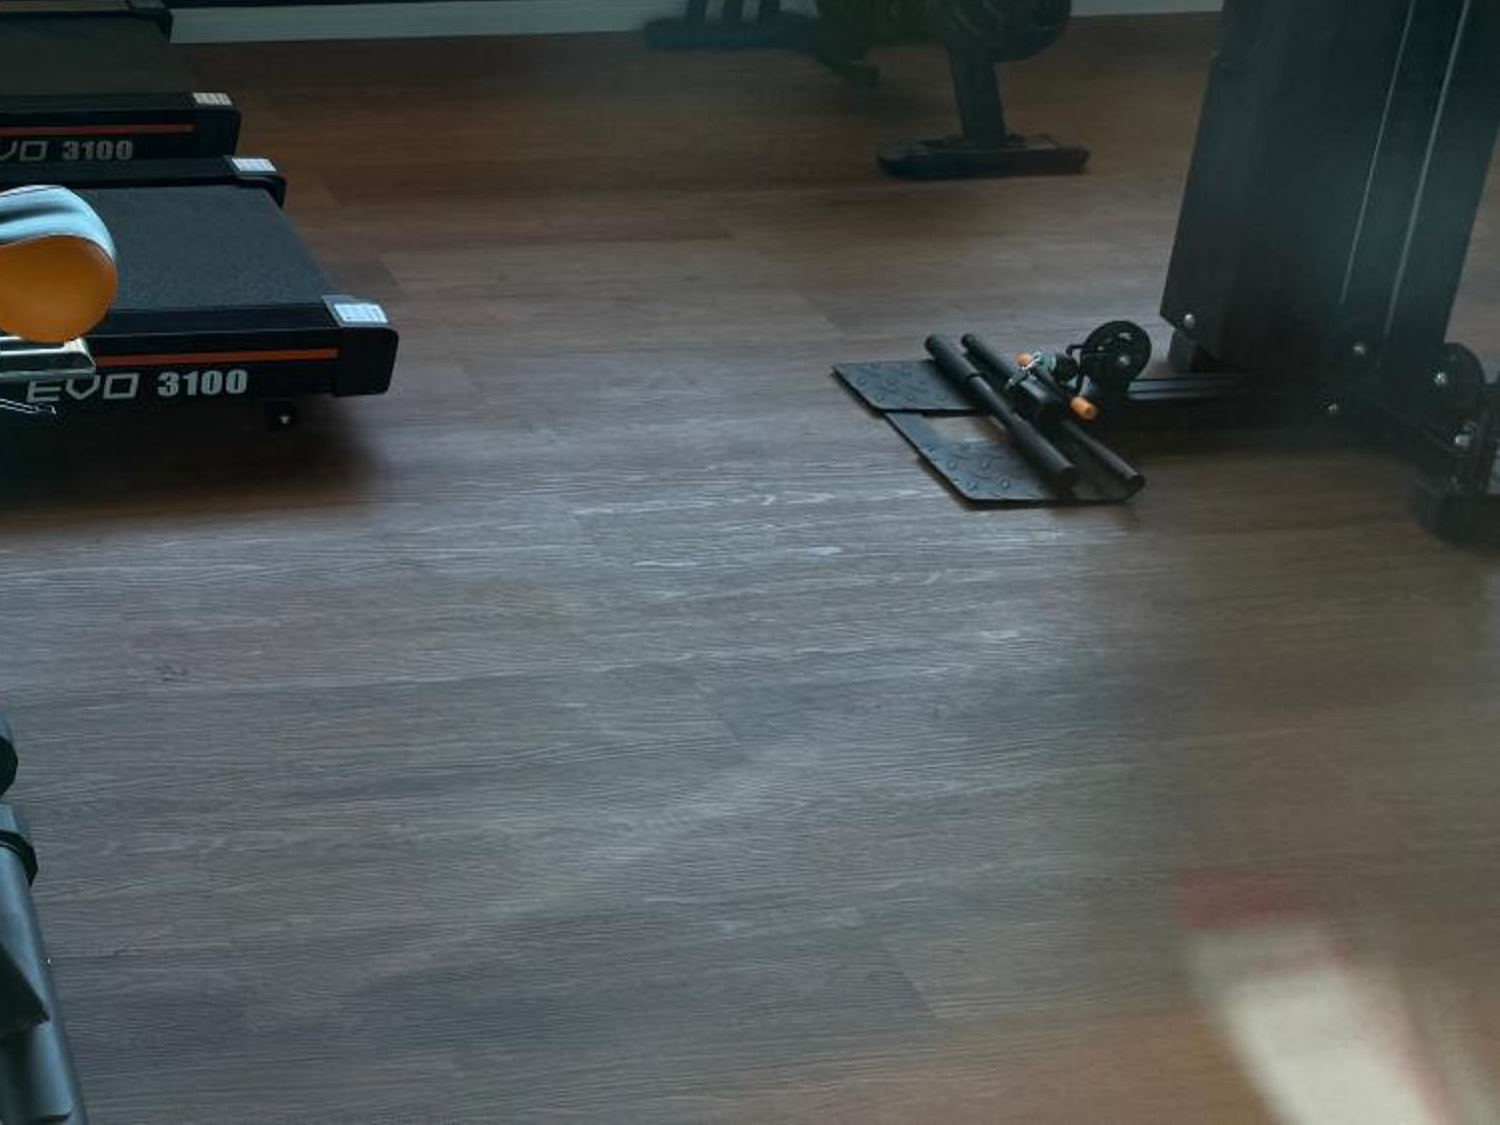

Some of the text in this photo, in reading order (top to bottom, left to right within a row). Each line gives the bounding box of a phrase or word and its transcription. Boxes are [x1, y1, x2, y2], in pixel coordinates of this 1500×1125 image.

[60, 138, 135, 162] 3100
[25, 369, 248, 404] EVO 3100
